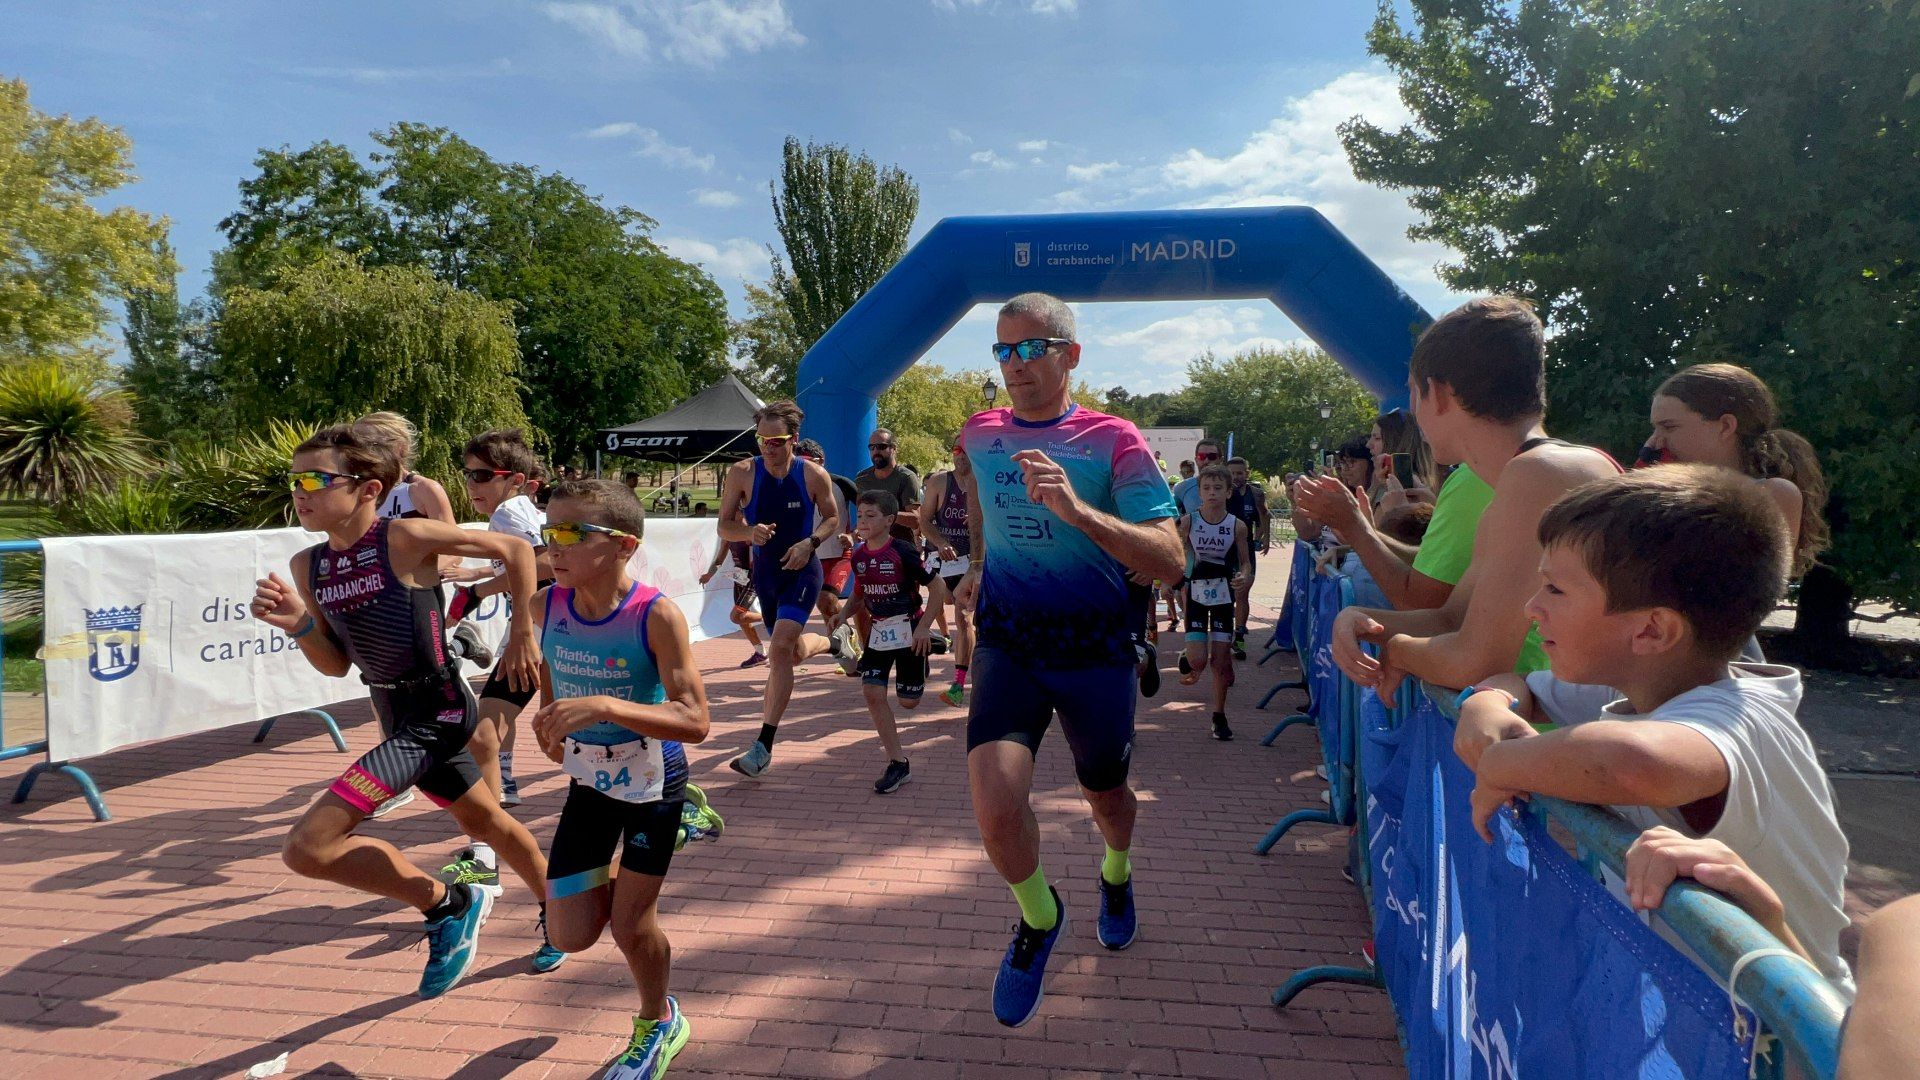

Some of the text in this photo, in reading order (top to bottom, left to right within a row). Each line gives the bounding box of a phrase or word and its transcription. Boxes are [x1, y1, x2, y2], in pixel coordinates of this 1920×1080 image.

[1047, 241, 1089, 252] distrito
[1131, 239, 1236, 262] MADRID
[1047, 254, 1114, 266] carabanchel
[620, 436, 688, 447] SCOTT
[315, 573, 385, 605] CARABANCHEL
[1203, 588, 1217, 599] 98
[429, 610, 445, 667] CARABANCHEL
[880, 628, 898, 643] 81
[554, 645, 599, 664] Triatlón
[553, 659, 631, 679] Valdebebas
[595, 766, 632, 792] 84
